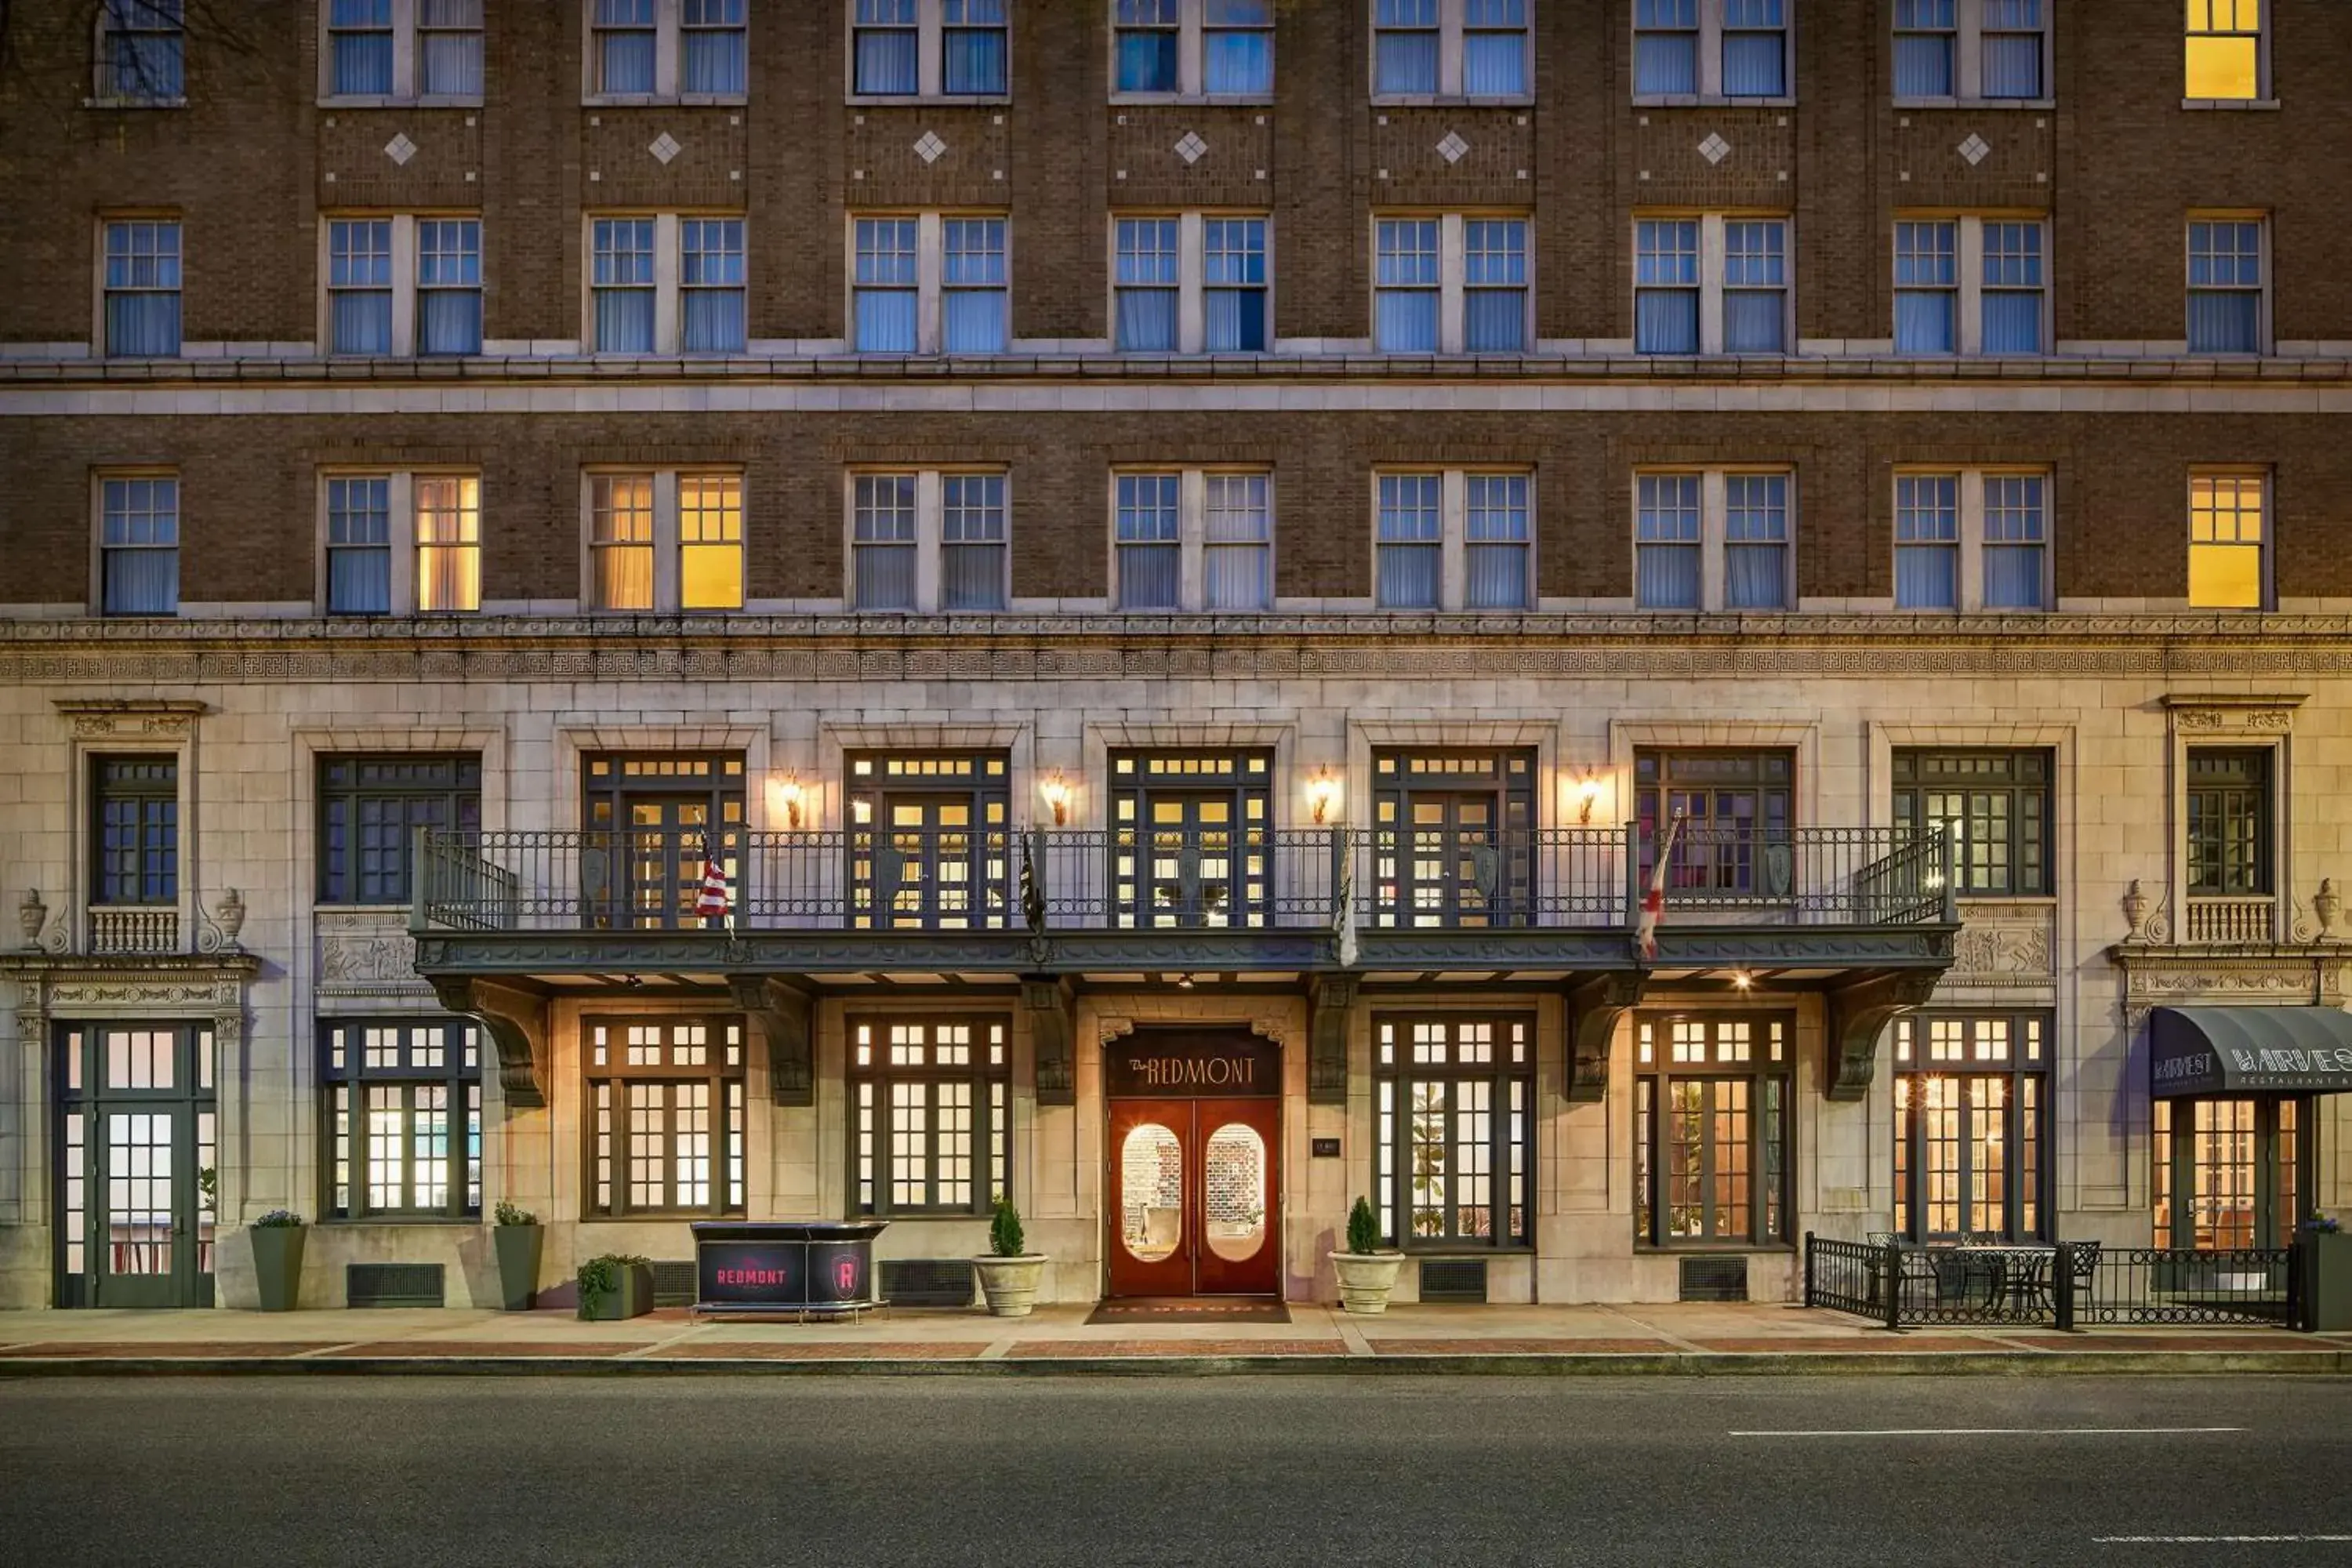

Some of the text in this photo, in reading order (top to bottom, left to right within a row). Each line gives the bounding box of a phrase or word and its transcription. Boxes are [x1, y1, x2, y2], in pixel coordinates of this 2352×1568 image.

[1129, 1058, 1254, 1084] The REDMONT
[2240, 1076, 2332, 1085] RESTAURANT
[717, 1269, 786, 1284] REDMONT
